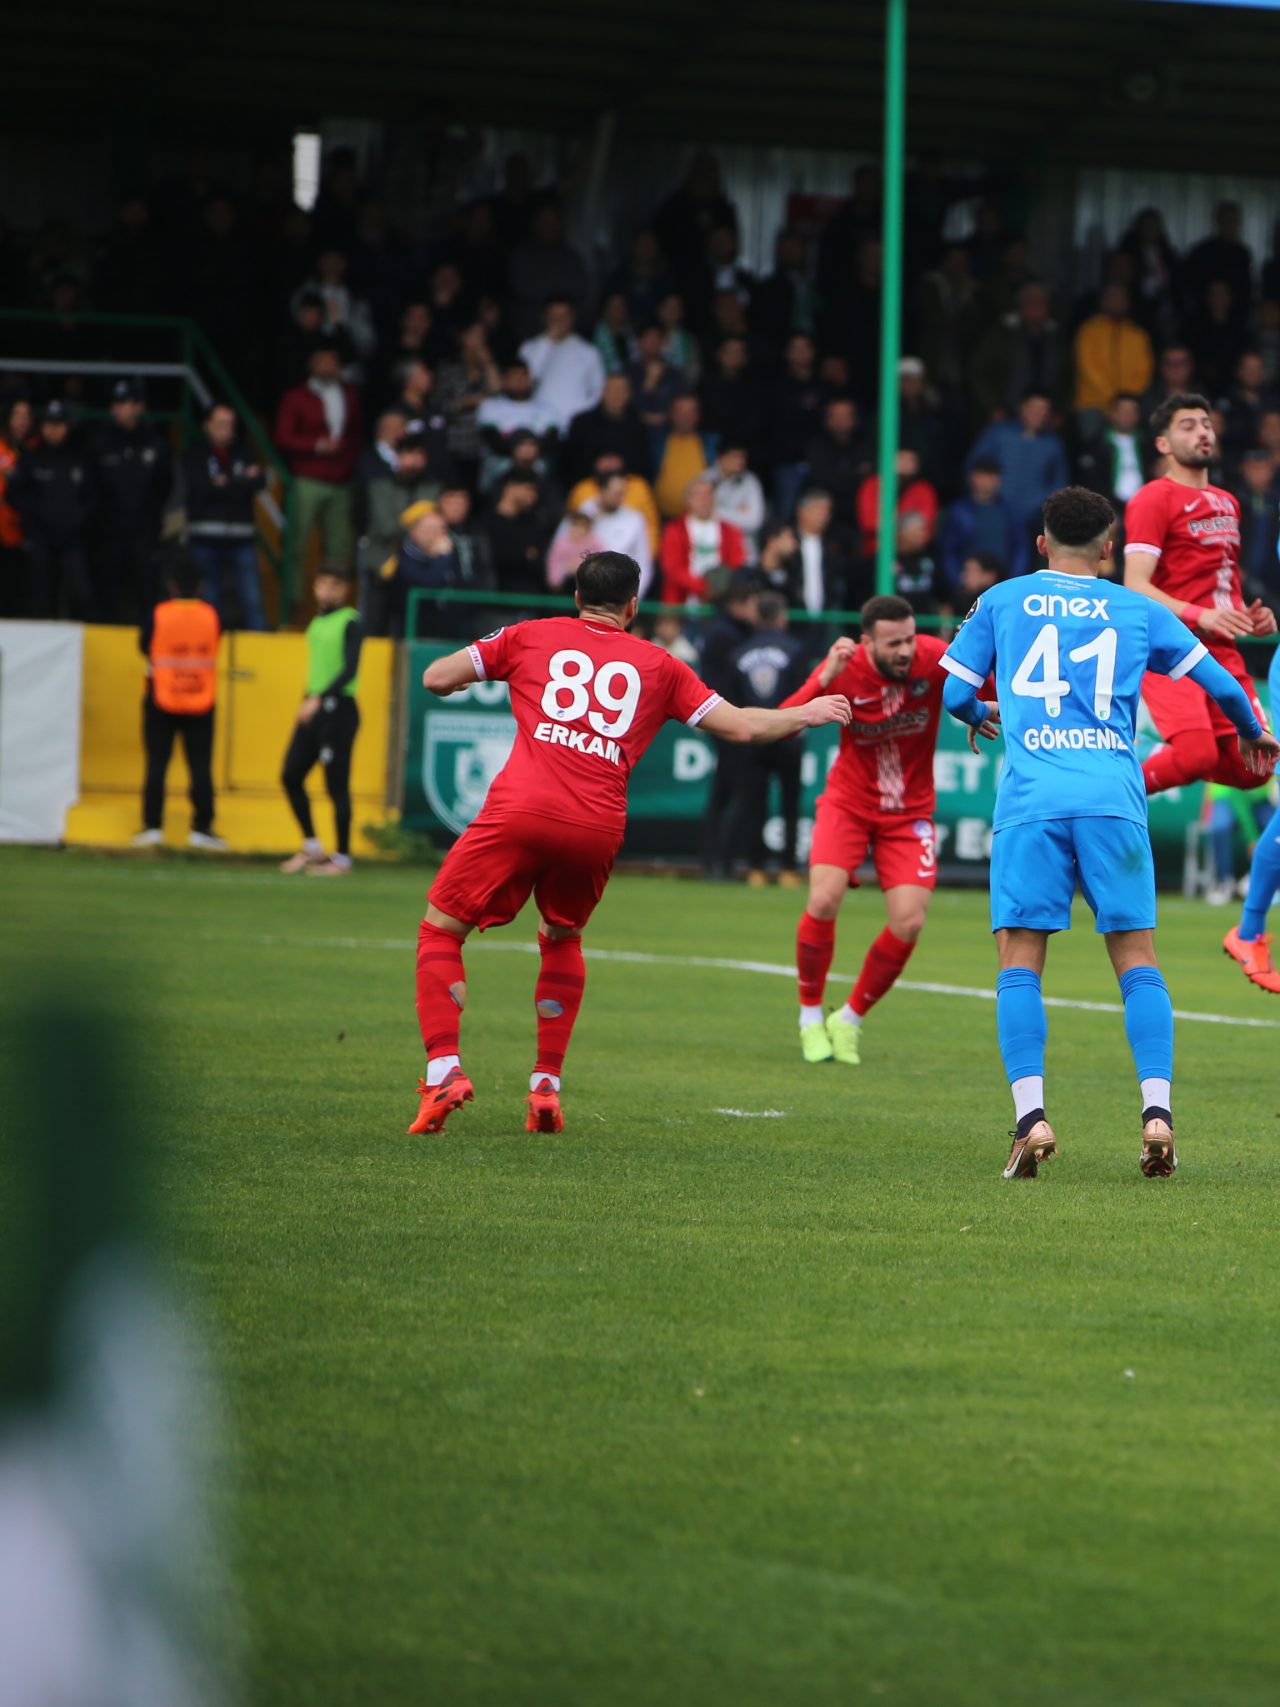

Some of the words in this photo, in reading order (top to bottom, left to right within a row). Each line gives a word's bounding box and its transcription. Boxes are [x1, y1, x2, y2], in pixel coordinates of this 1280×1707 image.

[1023, 593, 1110, 621] anex
[541, 649, 642, 738] 89
[1011, 623, 1118, 721] 41
[533, 722, 621, 767] ERKAM
[920, 838, 935, 868] 3
